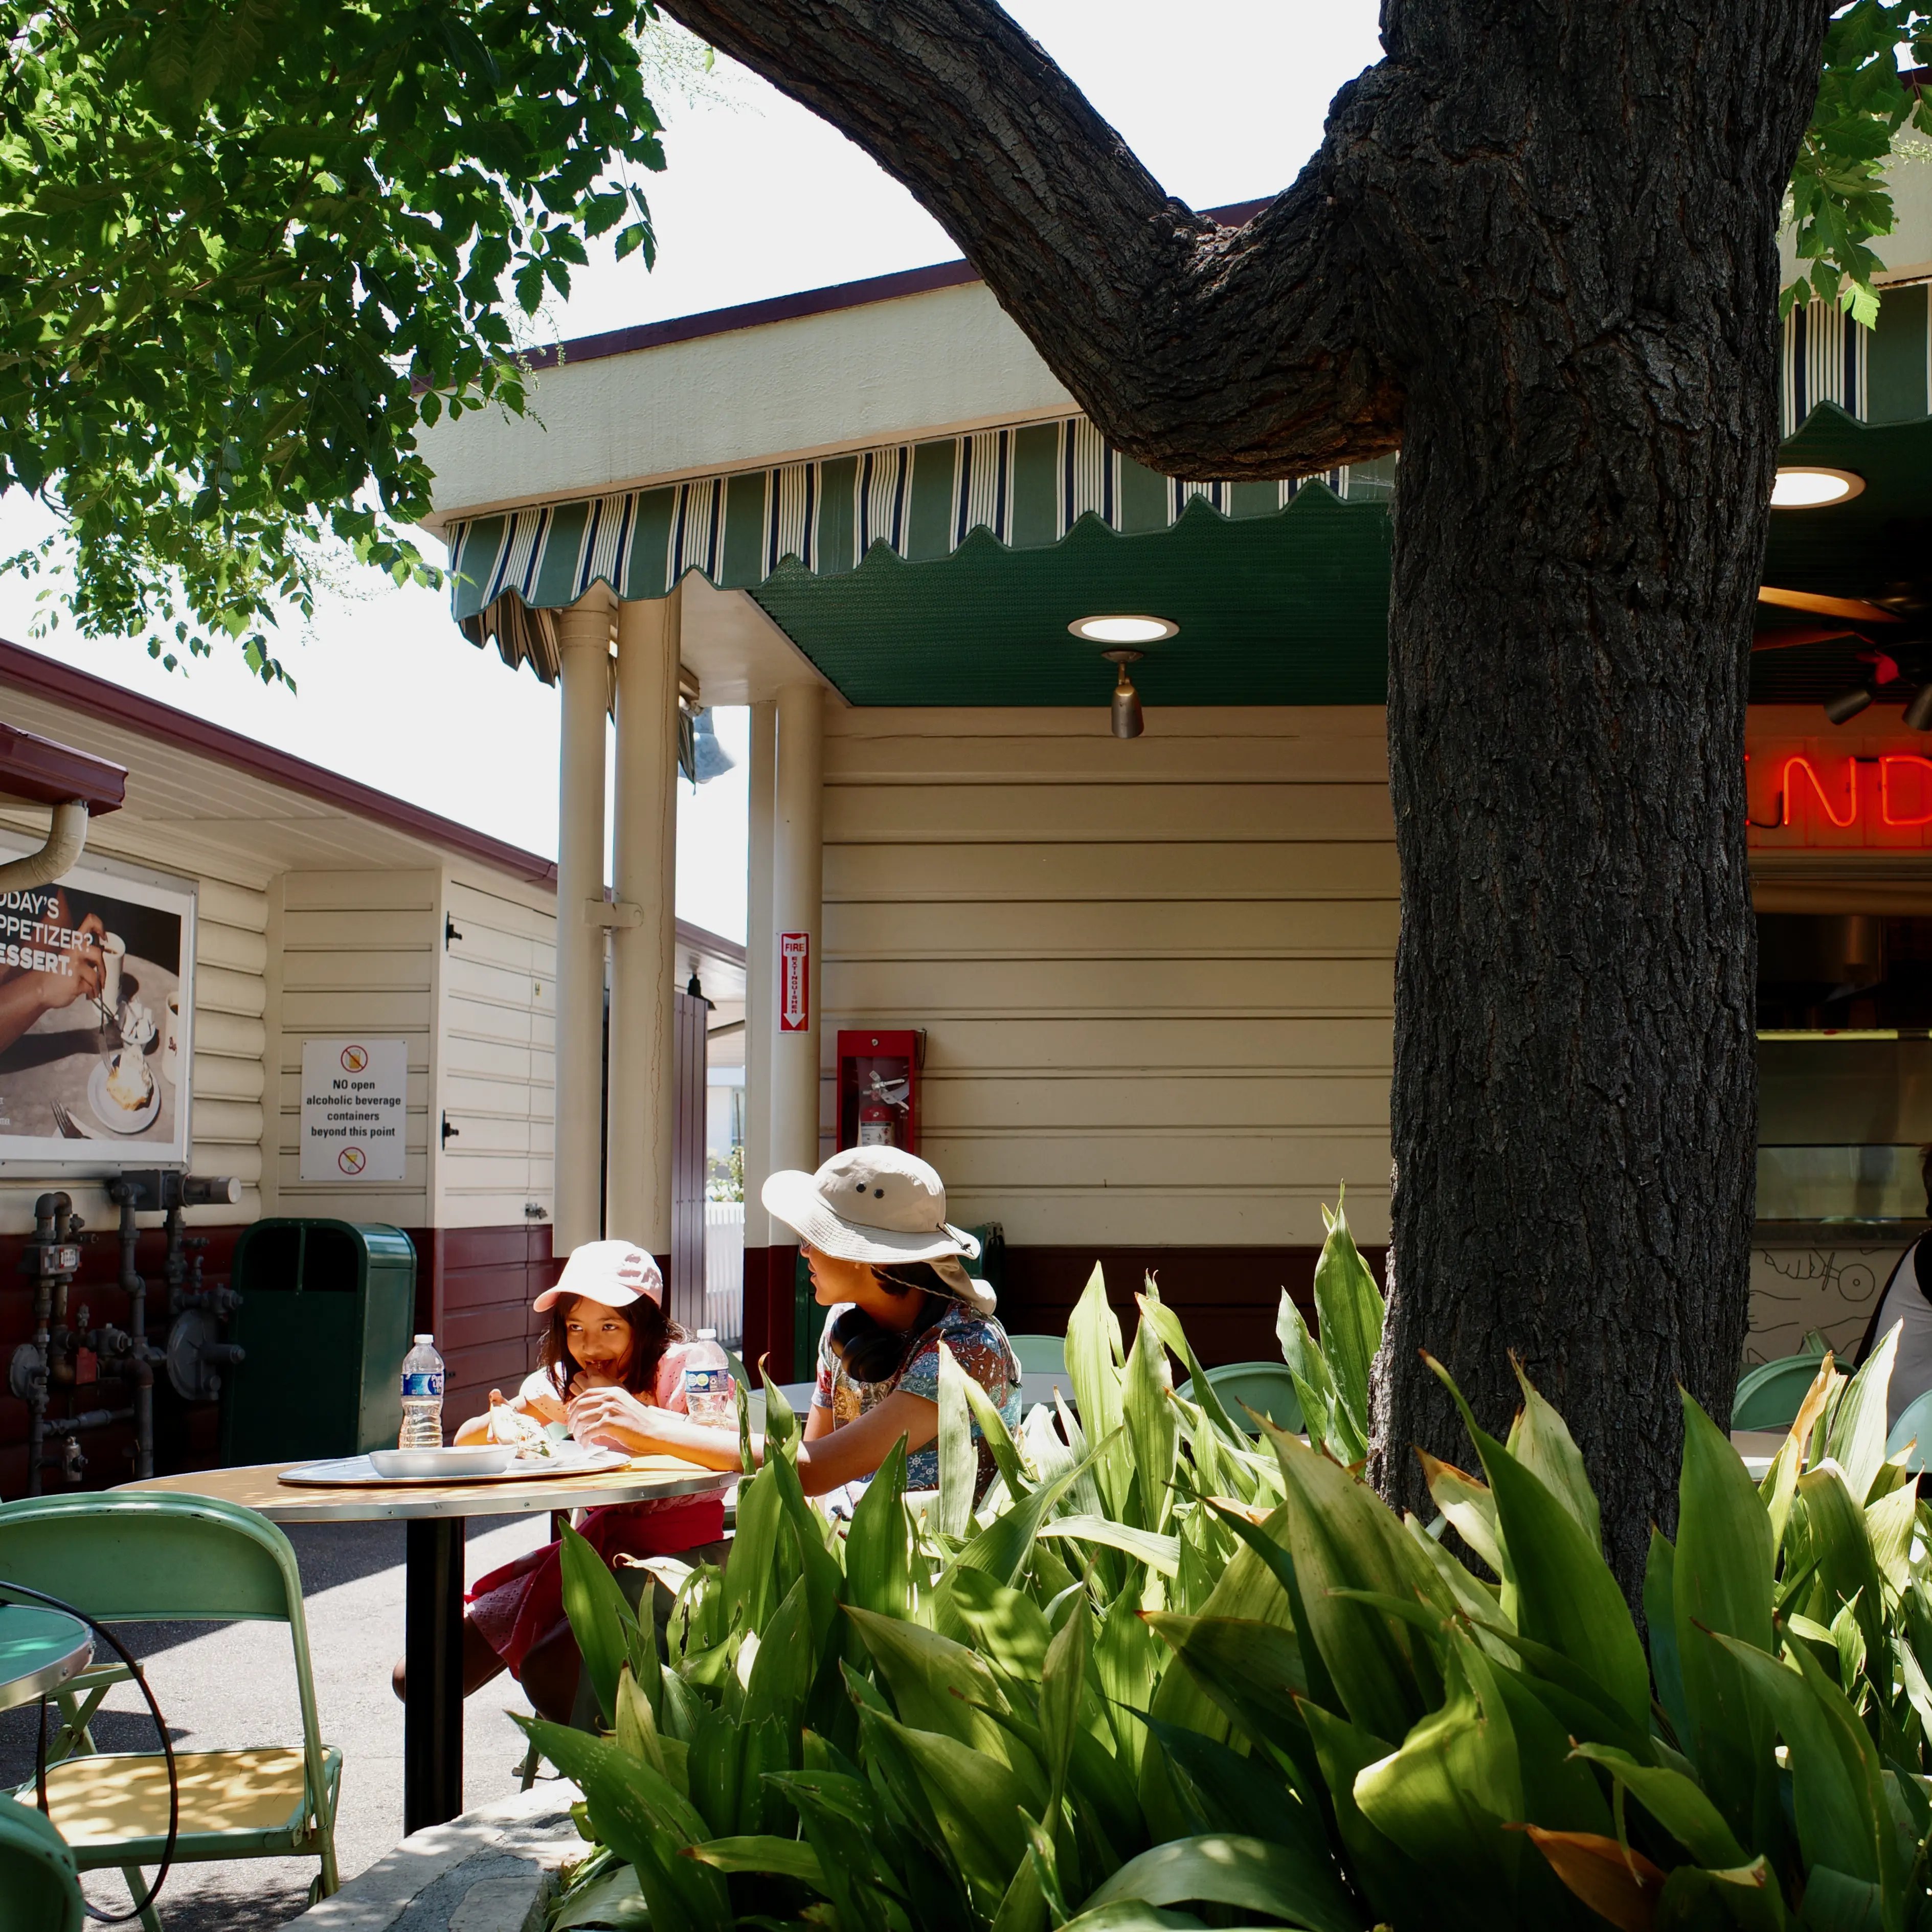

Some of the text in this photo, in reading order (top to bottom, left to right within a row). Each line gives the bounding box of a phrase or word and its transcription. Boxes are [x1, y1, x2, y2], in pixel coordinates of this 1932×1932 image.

[1745, 756, 1932, 827] ND
[785, 943, 805, 952] FIRE
[351, 1082, 375, 1092] open
[306, 1095, 401, 1107] alcoholic beverage
[327, 1111, 379, 1121] containers
[311, 1126, 395, 1139] beyond this point
